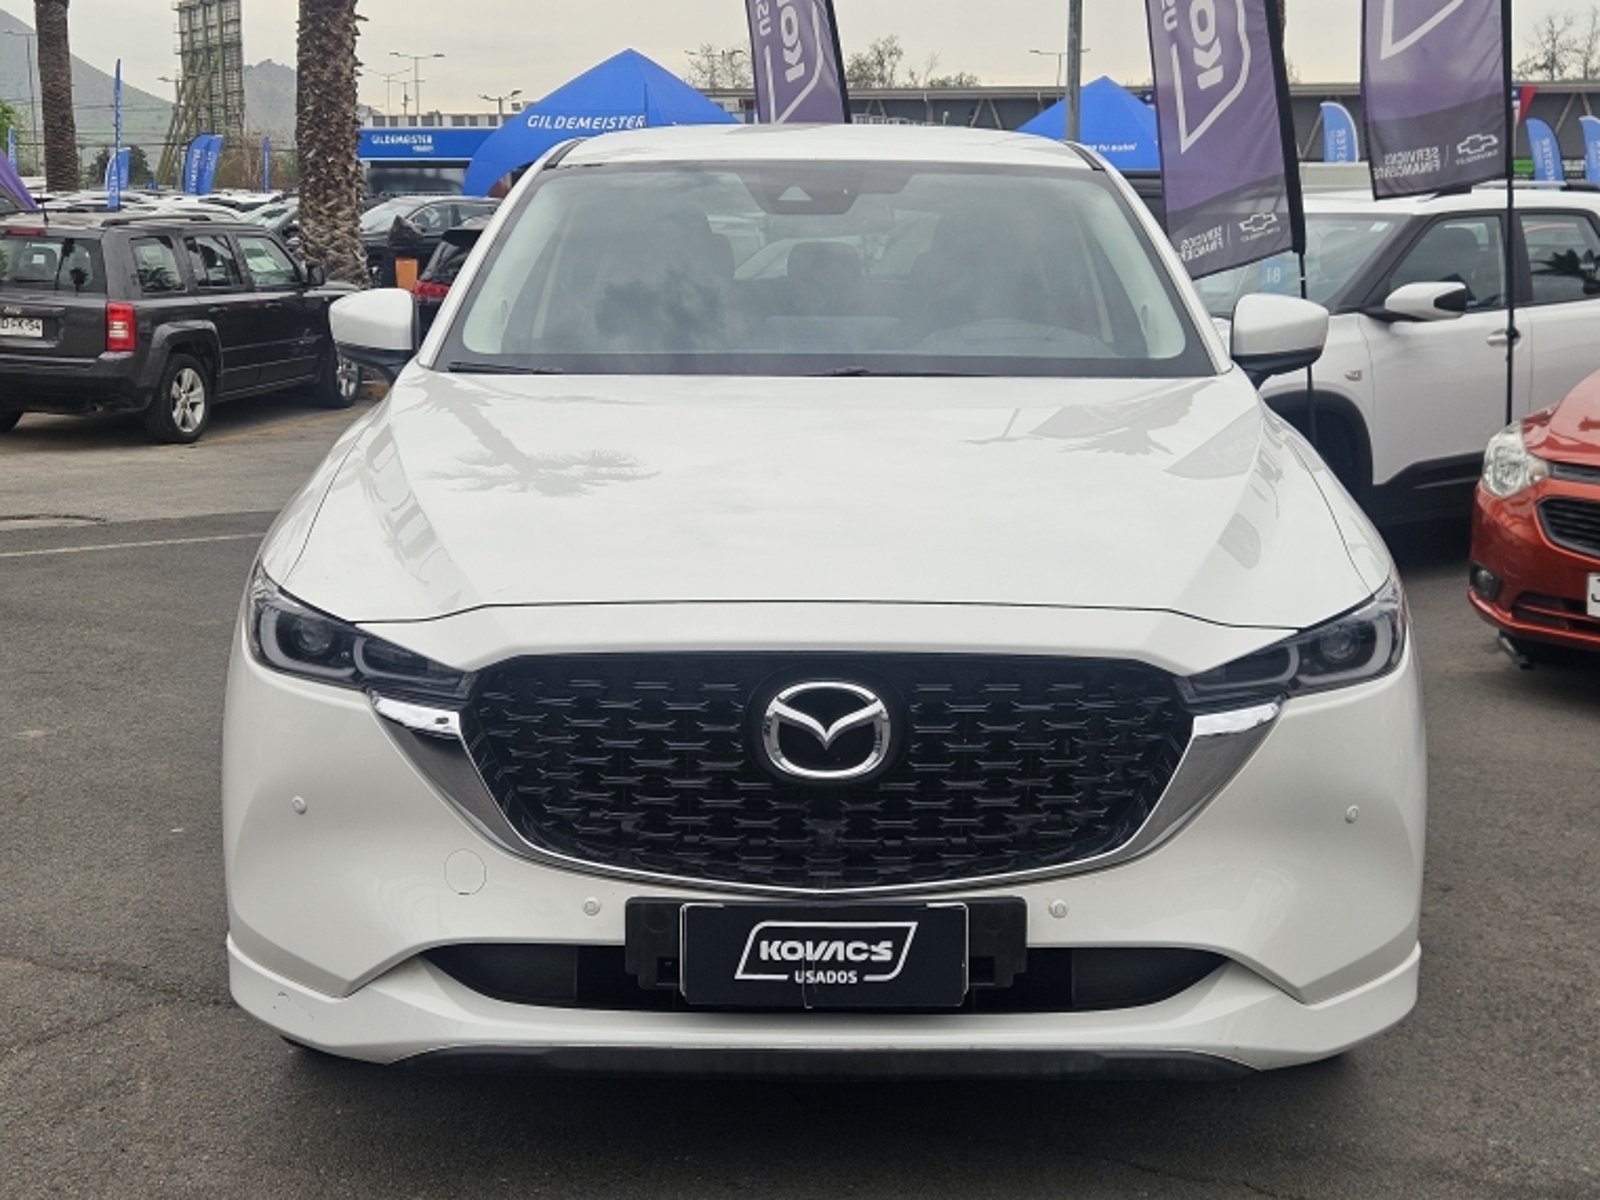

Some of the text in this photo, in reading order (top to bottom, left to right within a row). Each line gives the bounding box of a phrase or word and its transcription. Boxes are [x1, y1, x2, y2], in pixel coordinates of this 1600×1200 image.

[527, 115, 645, 129] GILDEMEISTER
[759, 940, 893, 961] KOVACS
[794, 970, 858, 984] USADOS
